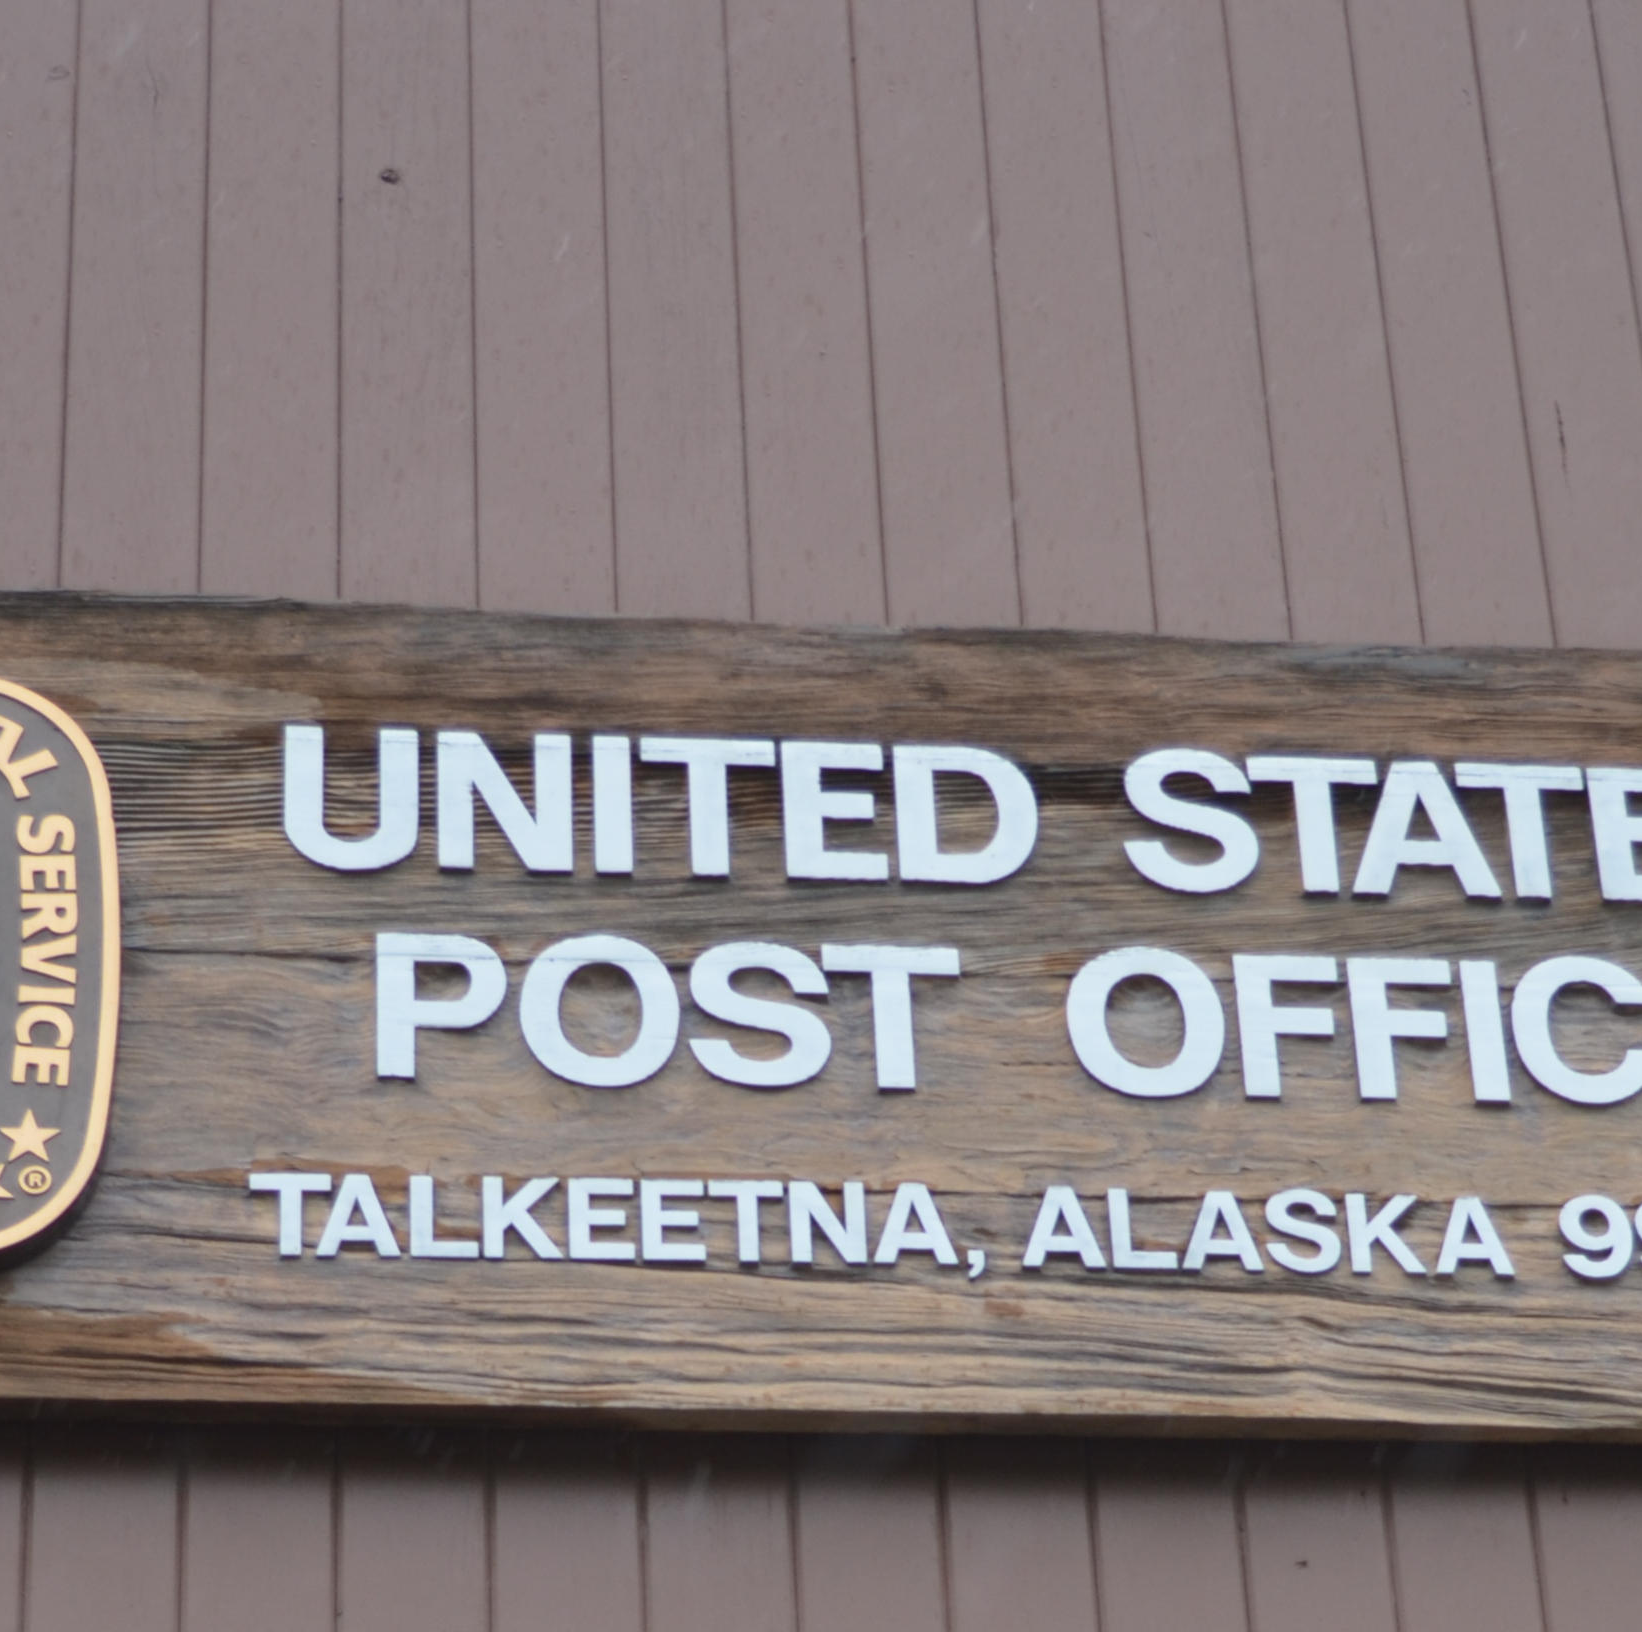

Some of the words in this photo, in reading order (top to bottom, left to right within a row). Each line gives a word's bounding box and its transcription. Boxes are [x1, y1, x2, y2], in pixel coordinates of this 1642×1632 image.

[282, 723, 1039, 884] UNITED
[11, 813, 79, 1087] SERVICE
[374, 931, 962, 1089] POST
[246, 1171, 987, 1279] TALKEETNA,
[1022, 1185, 1517, 1276] ALASKA
